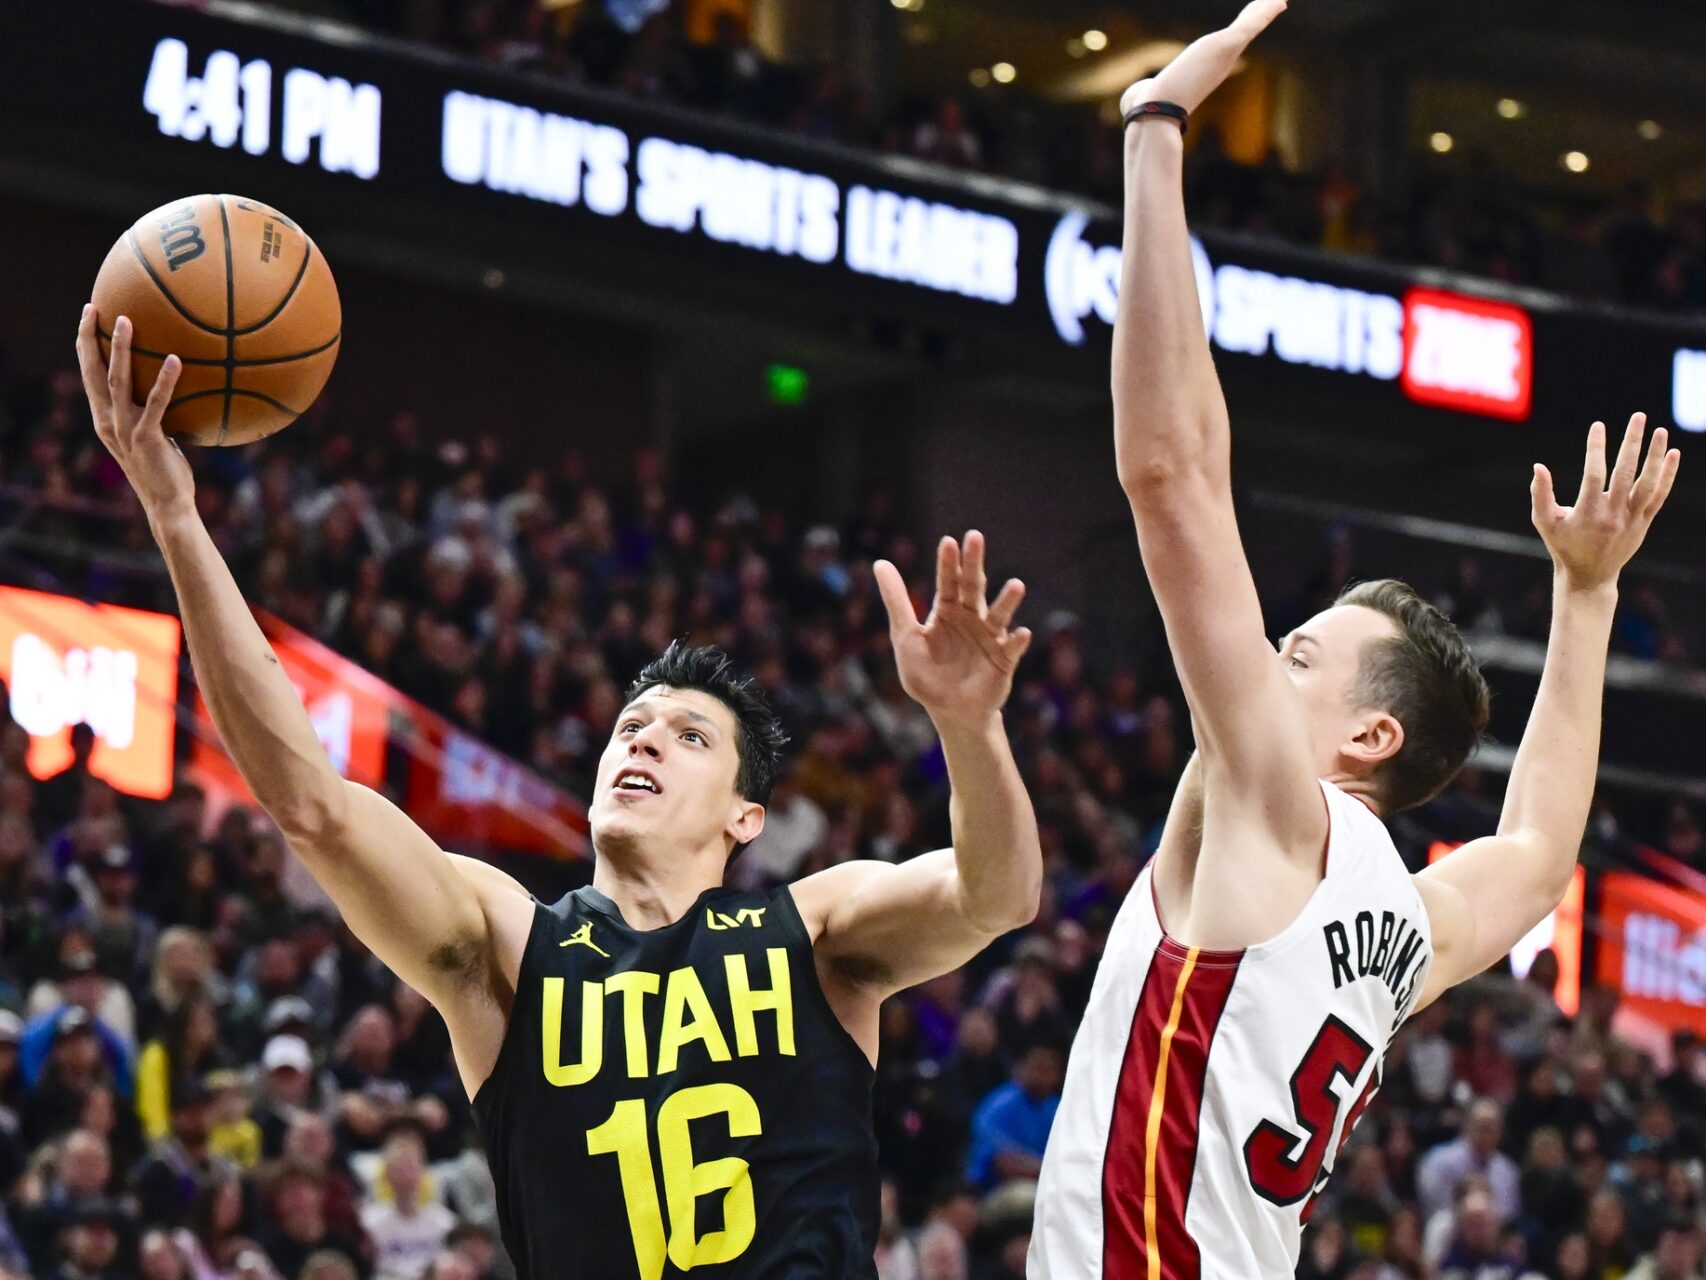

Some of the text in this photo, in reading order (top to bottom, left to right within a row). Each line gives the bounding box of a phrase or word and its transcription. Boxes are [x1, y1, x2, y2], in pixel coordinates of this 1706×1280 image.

[144, 37, 382, 180] 4:41 PM
[635, 136, 841, 264] SPORTS
[541, 946, 797, 1087] UTAH
